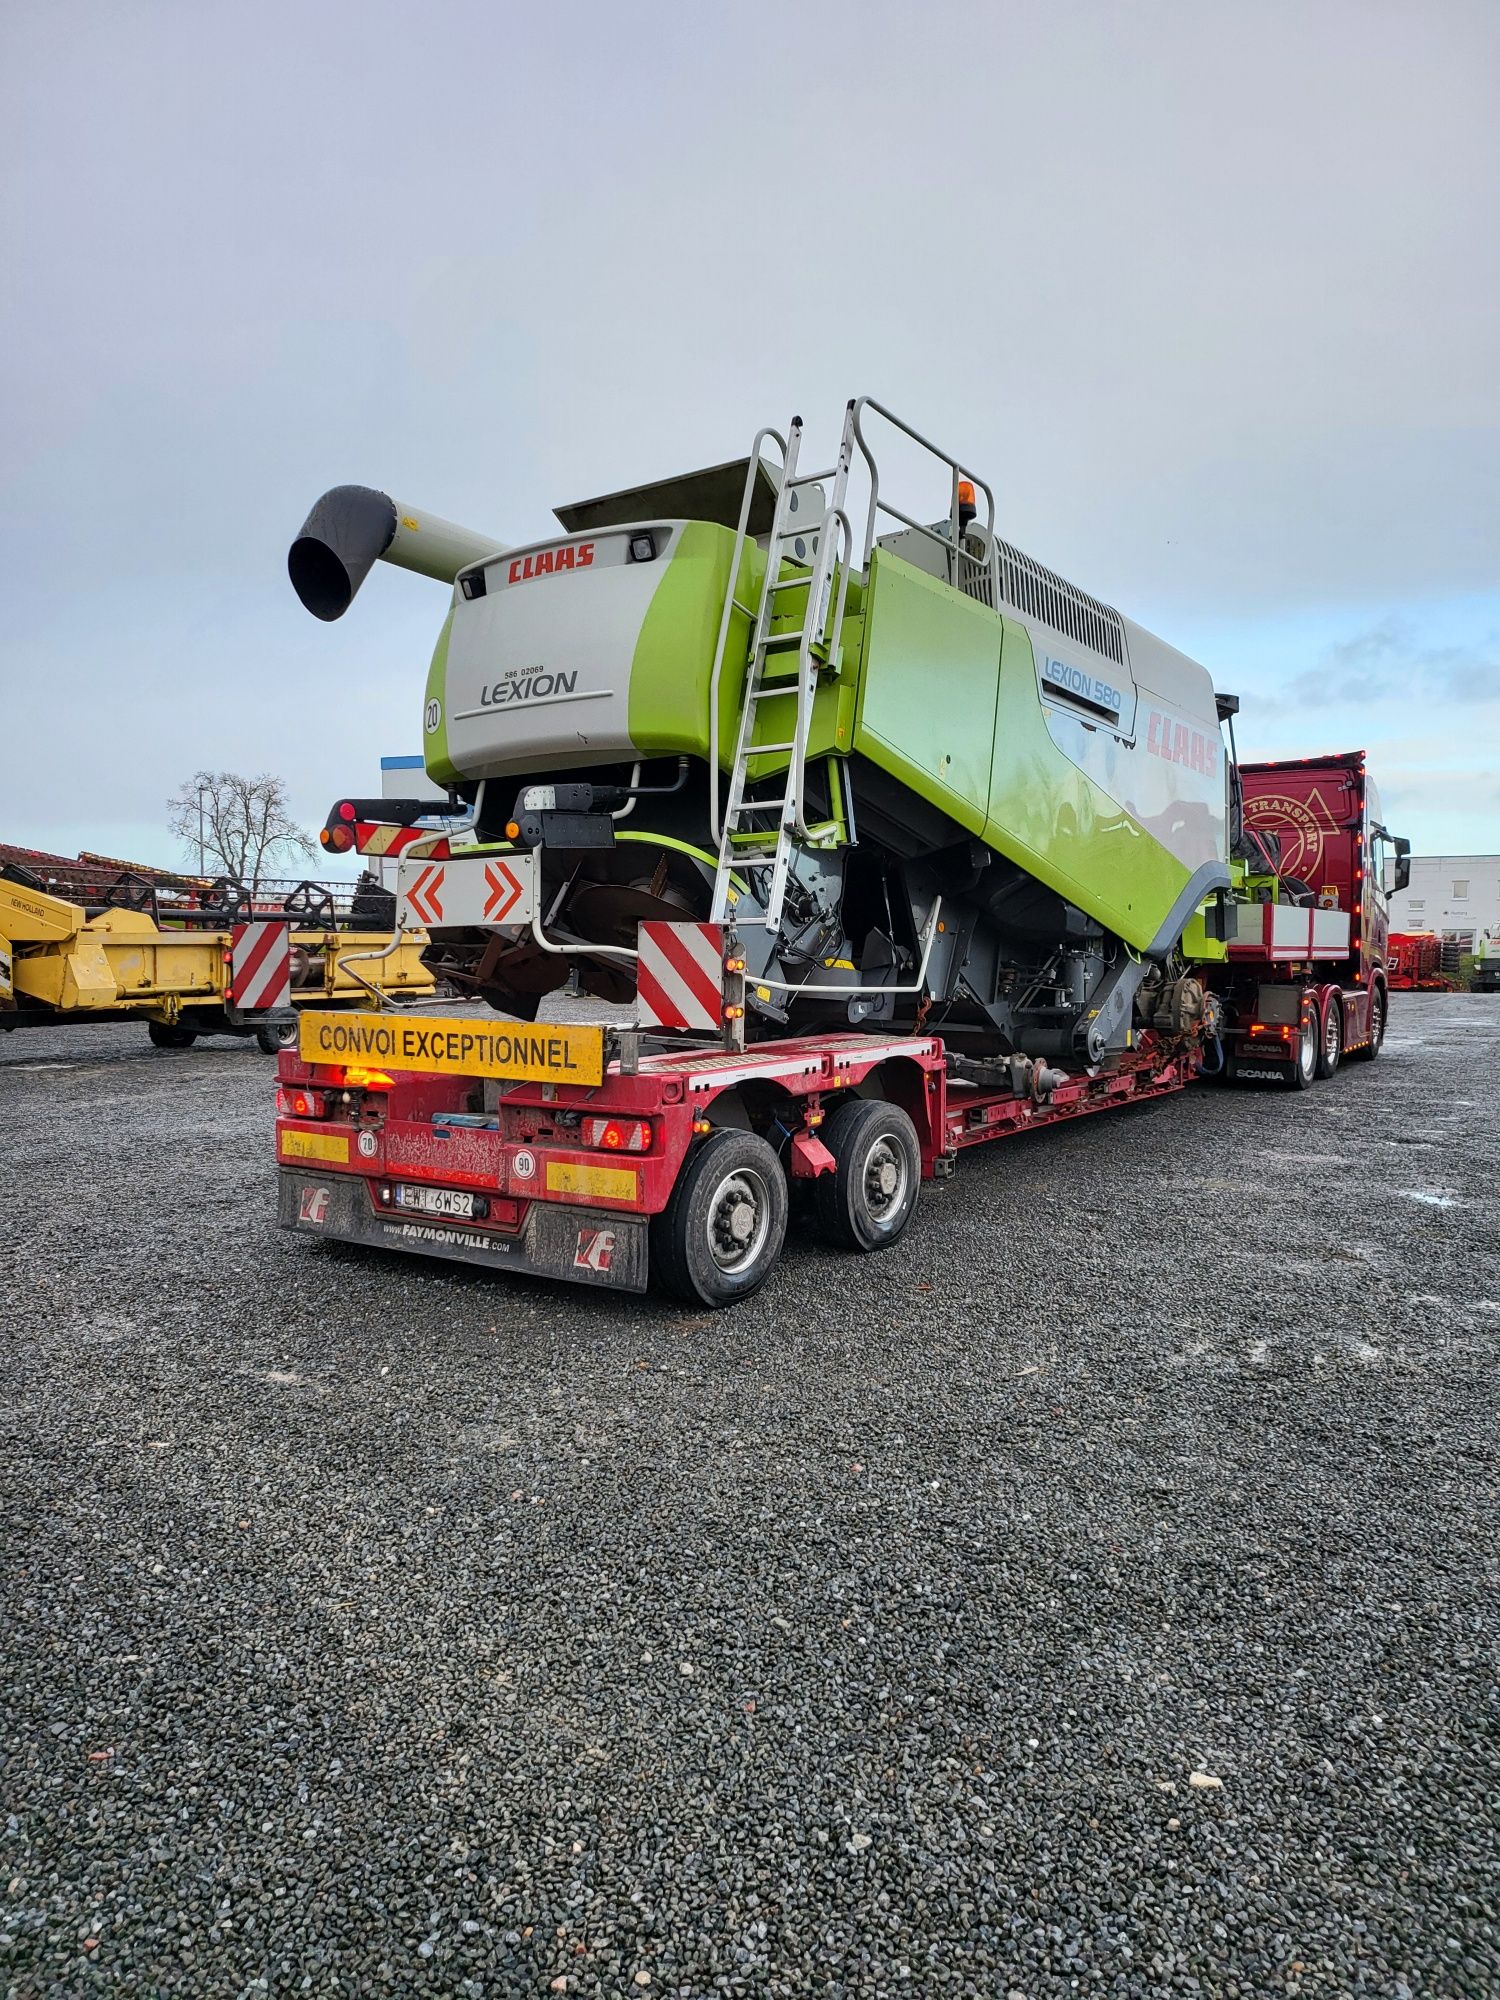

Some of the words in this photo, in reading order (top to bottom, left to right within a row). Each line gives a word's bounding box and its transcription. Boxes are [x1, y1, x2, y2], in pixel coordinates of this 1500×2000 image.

[508, 543, 595, 584] CLAAS
[520, 665, 544, 676] 02069
[480, 670, 578, 706] LEXION
[1045, 656, 1092, 698] LEXION
[1094, 680, 1122, 711] 580
[427, 703, 438, 729] 20
[1146, 711, 1218, 779] CLAAS
[1249, 799, 1318, 853] TRANSPORT
[22, 903, 45, 916] HOLLAND
[319, 1025, 396, 1056] CONVOI
[402, 1030, 577, 1069] EXCEPTIONNEL
[1243, 1043, 1282, 1053] SCANIA
[1236, 1068, 1285, 1080] SCANIA
[362, 1136, 373, 1151] 70
[518, 1156, 530, 1172] 90
[434, 1191, 471, 1214] 6WS2
